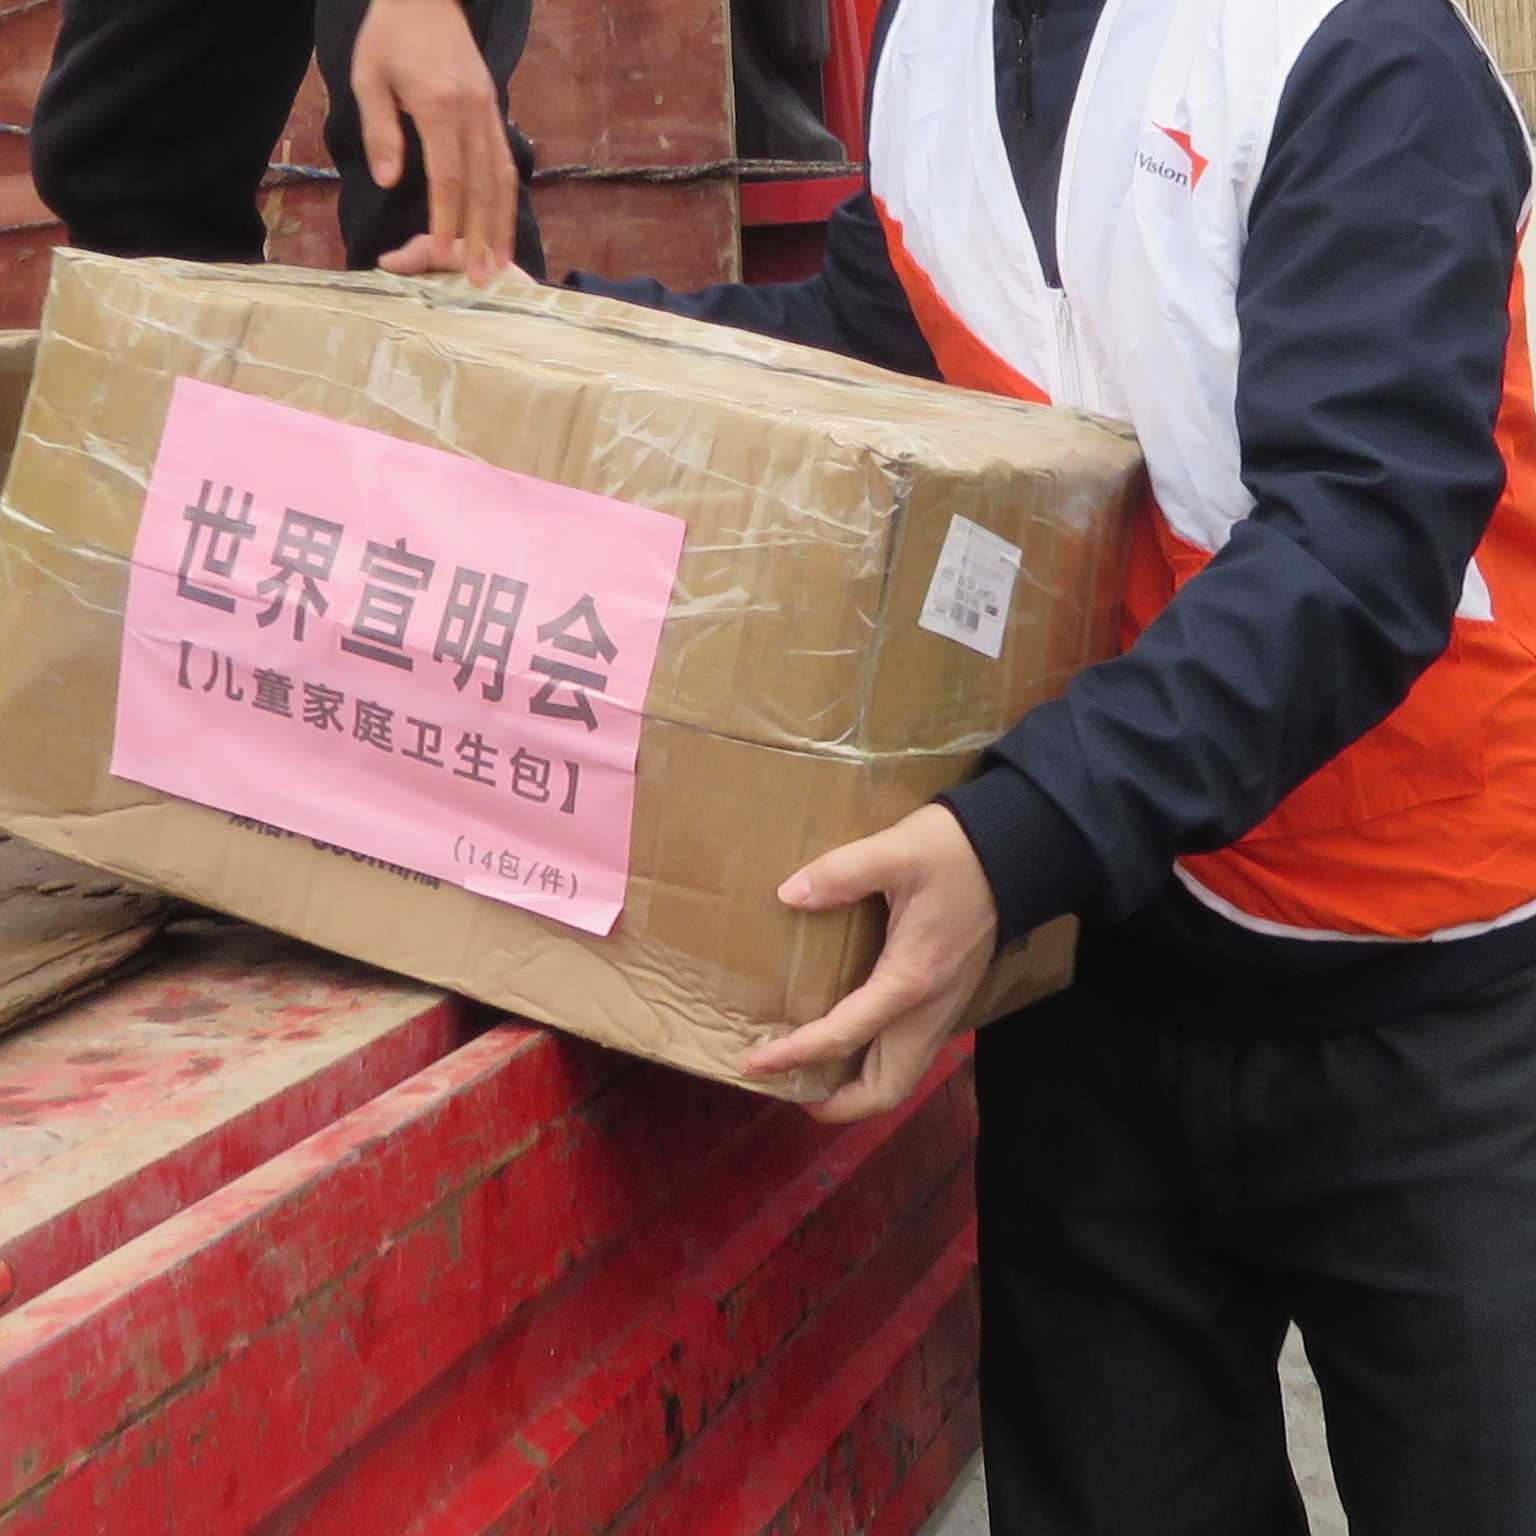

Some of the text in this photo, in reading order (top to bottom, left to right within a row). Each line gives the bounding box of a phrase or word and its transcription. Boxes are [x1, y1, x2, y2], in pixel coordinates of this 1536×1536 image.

[1139, 152, 1188, 186] Vision
[176, 479, 619, 732] 世界宣明会
[176, 640, 580, 814] 【儿童家庭卫生包】
